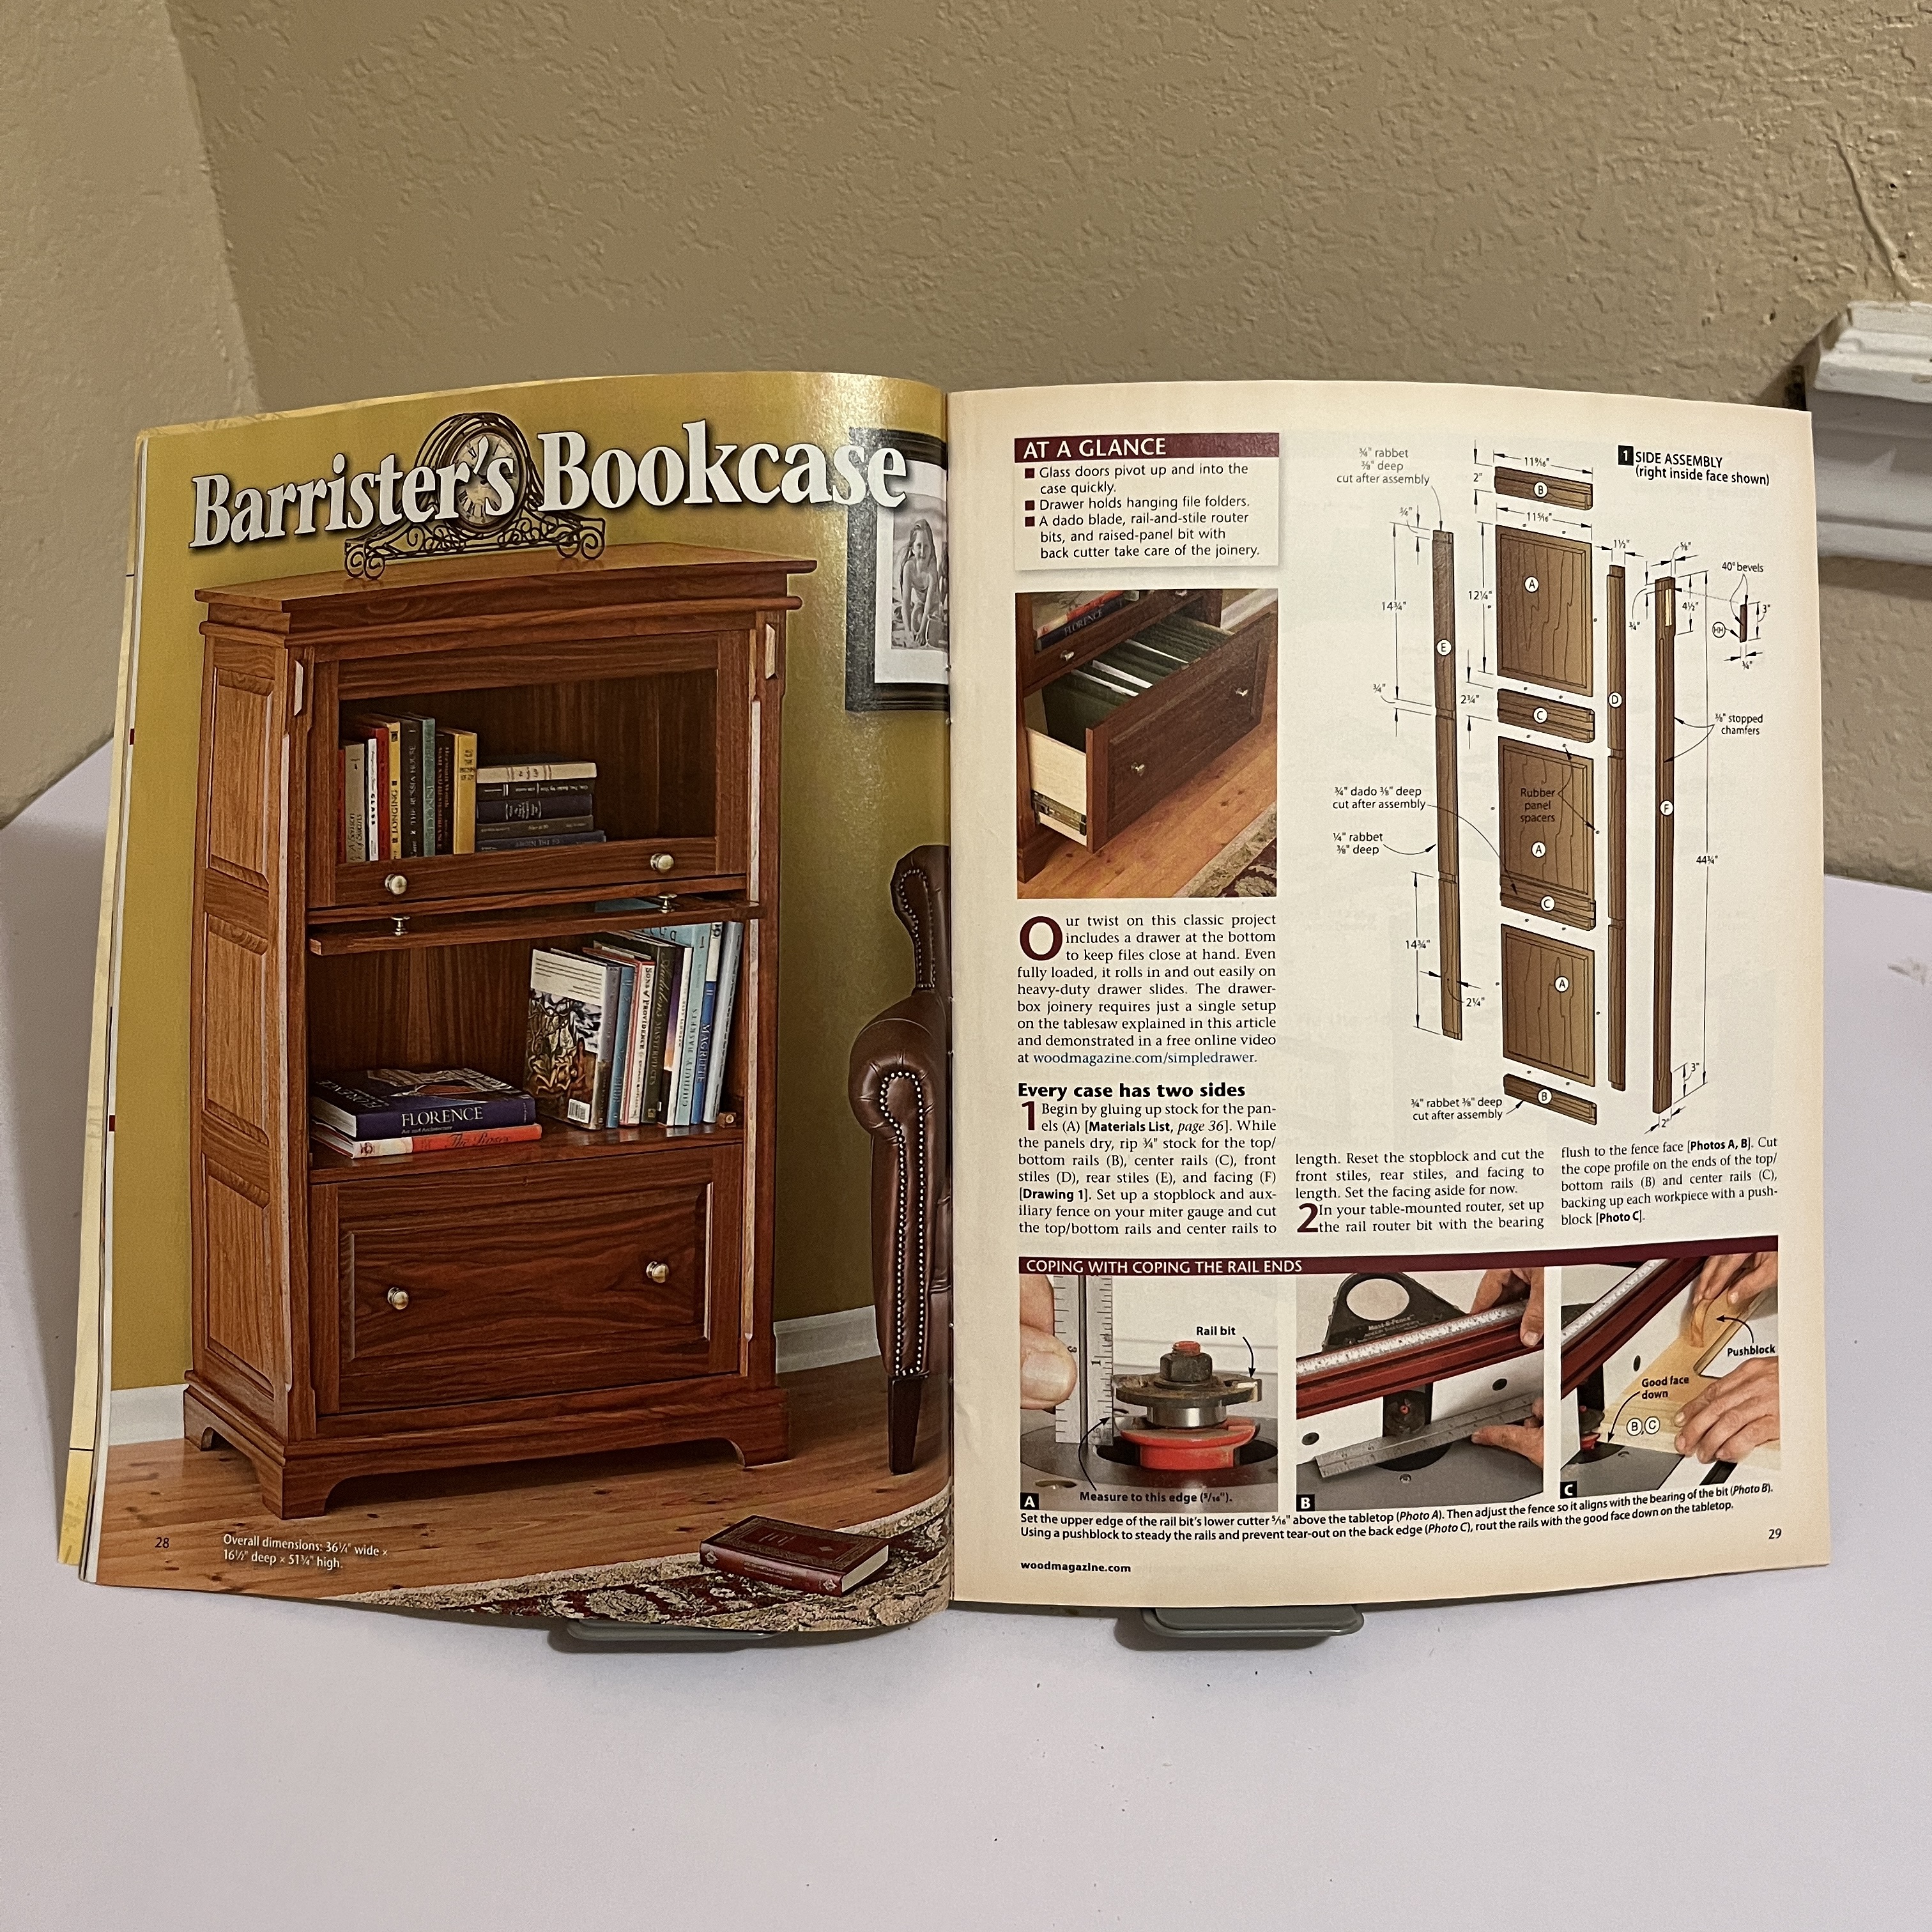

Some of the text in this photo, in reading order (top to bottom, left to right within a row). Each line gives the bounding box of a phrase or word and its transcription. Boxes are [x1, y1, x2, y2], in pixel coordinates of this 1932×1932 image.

[1023, 438, 1167, 459] AT A GLANCE
[1623, 450, 1629, 462] 1
[1635, 451, 1723, 468] SIDE ASSEMBLY
[1039, 462, 1248, 480] Glass doors pivot up and into the
[1636, 464, 1770, 487] (right inside face shown)
[189, 419, 908, 549] Barrister's Bookcase
[1040, 480, 1116, 496] case quickly.
[1538, 486, 1544, 494] B
[1039, 494, 1250, 511] Drawer holds hanging file folders.
[1039, 511, 1249, 527] A dado blade, rail-and-stile router
[1040, 527, 1225, 544] bits, and raised-panel bit with
[1041, 544, 1260, 559] back cutter take care of the joinery.
[1721, 562, 1764, 572] 40° bevels
[1529, 579, 1536, 590] A
[1064, 609, 1103, 636] FLORENCE
[1440, 643, 1446, 652] E
[1611, 694, 1619, 705] D
[1537, 709, 1544, 721] C
[1728, 714, 1763, 725] stopped
[1721, 724, 1760, 735] chamfers
[1350, 786, 1377, 796] dado
[1395, 786, 1422, 799] deep
[1521, 787, 1556, 798] Rubber
[1332, 798, 1426, 811] cut after assembly
[1524, 799, 1551, 812] panel
[1663, 804, 1669, 813] F
[389, 790, 399, 834] LONGING
[1520, 815, 1556, 825] spacers
[1535, 845, 1542, 855] A
[1544, 899, 1551, 908] C
[1017, 965, 1276, 981] fully loaded, it rolls in and out easily on
[1017, 983, 1276, 999] heavy-duty drawer slides. The drawer-
[1558, 979, 1565, 990] A
[1017, 1000, 1276, 1016] box joinery requires just a single setup
[696, 1023, 711, 1084] MAGRITTE
[1017, 1051, 1257, 1067] at woodmagazine.com/simpledrawer.
[1018, 1082, 1245, 1102] Every case has two sides
[1541, 1092, 1547, 1103] B
[401, 1106, 484, 1127] FLORENCE
[1561, 1169, 1777, 1192] bottom rails (B) and center rails (C),
[1296, 1183, 1517, 1202] length. Set the facing aside for now.
[1026, 1259, 1303, 1273] COPING WITH COPING THE RAIL ENDS
[1196, 1326, 1236, 1336] Rail bit
[1727, 1344, 1775, 1357] Pushblock
[1641, 1375, 1689, 1388] Good face
[1641, 1390, 1669, 1400] down
[1564, 1483, 1573, 1496] C
[1024, 1496, 1036, 1508] A
[1080, 1491, 1128, 1502] Measure
[1130, 1493, 1142, 1502] to
[1145, 1492, 1166, 1502] this
[1169, 1492, 1197, 1505] edge
[1301, 1498, 1310, 1510] B
[1768, 1528, 1782, 1540] 29
[155, 1537, 170, 1549] 28
[223, 1533, 259, 1547] Overall
[262, 1537, 323, 1551] dimensions:
[354, 1544, 379, 1556] wide
[251, 1551, 277, 1566] deep
[317, 1556, 343, 1571] high.
[1020, 1561, 1131, 1574] woodmagazine.com
